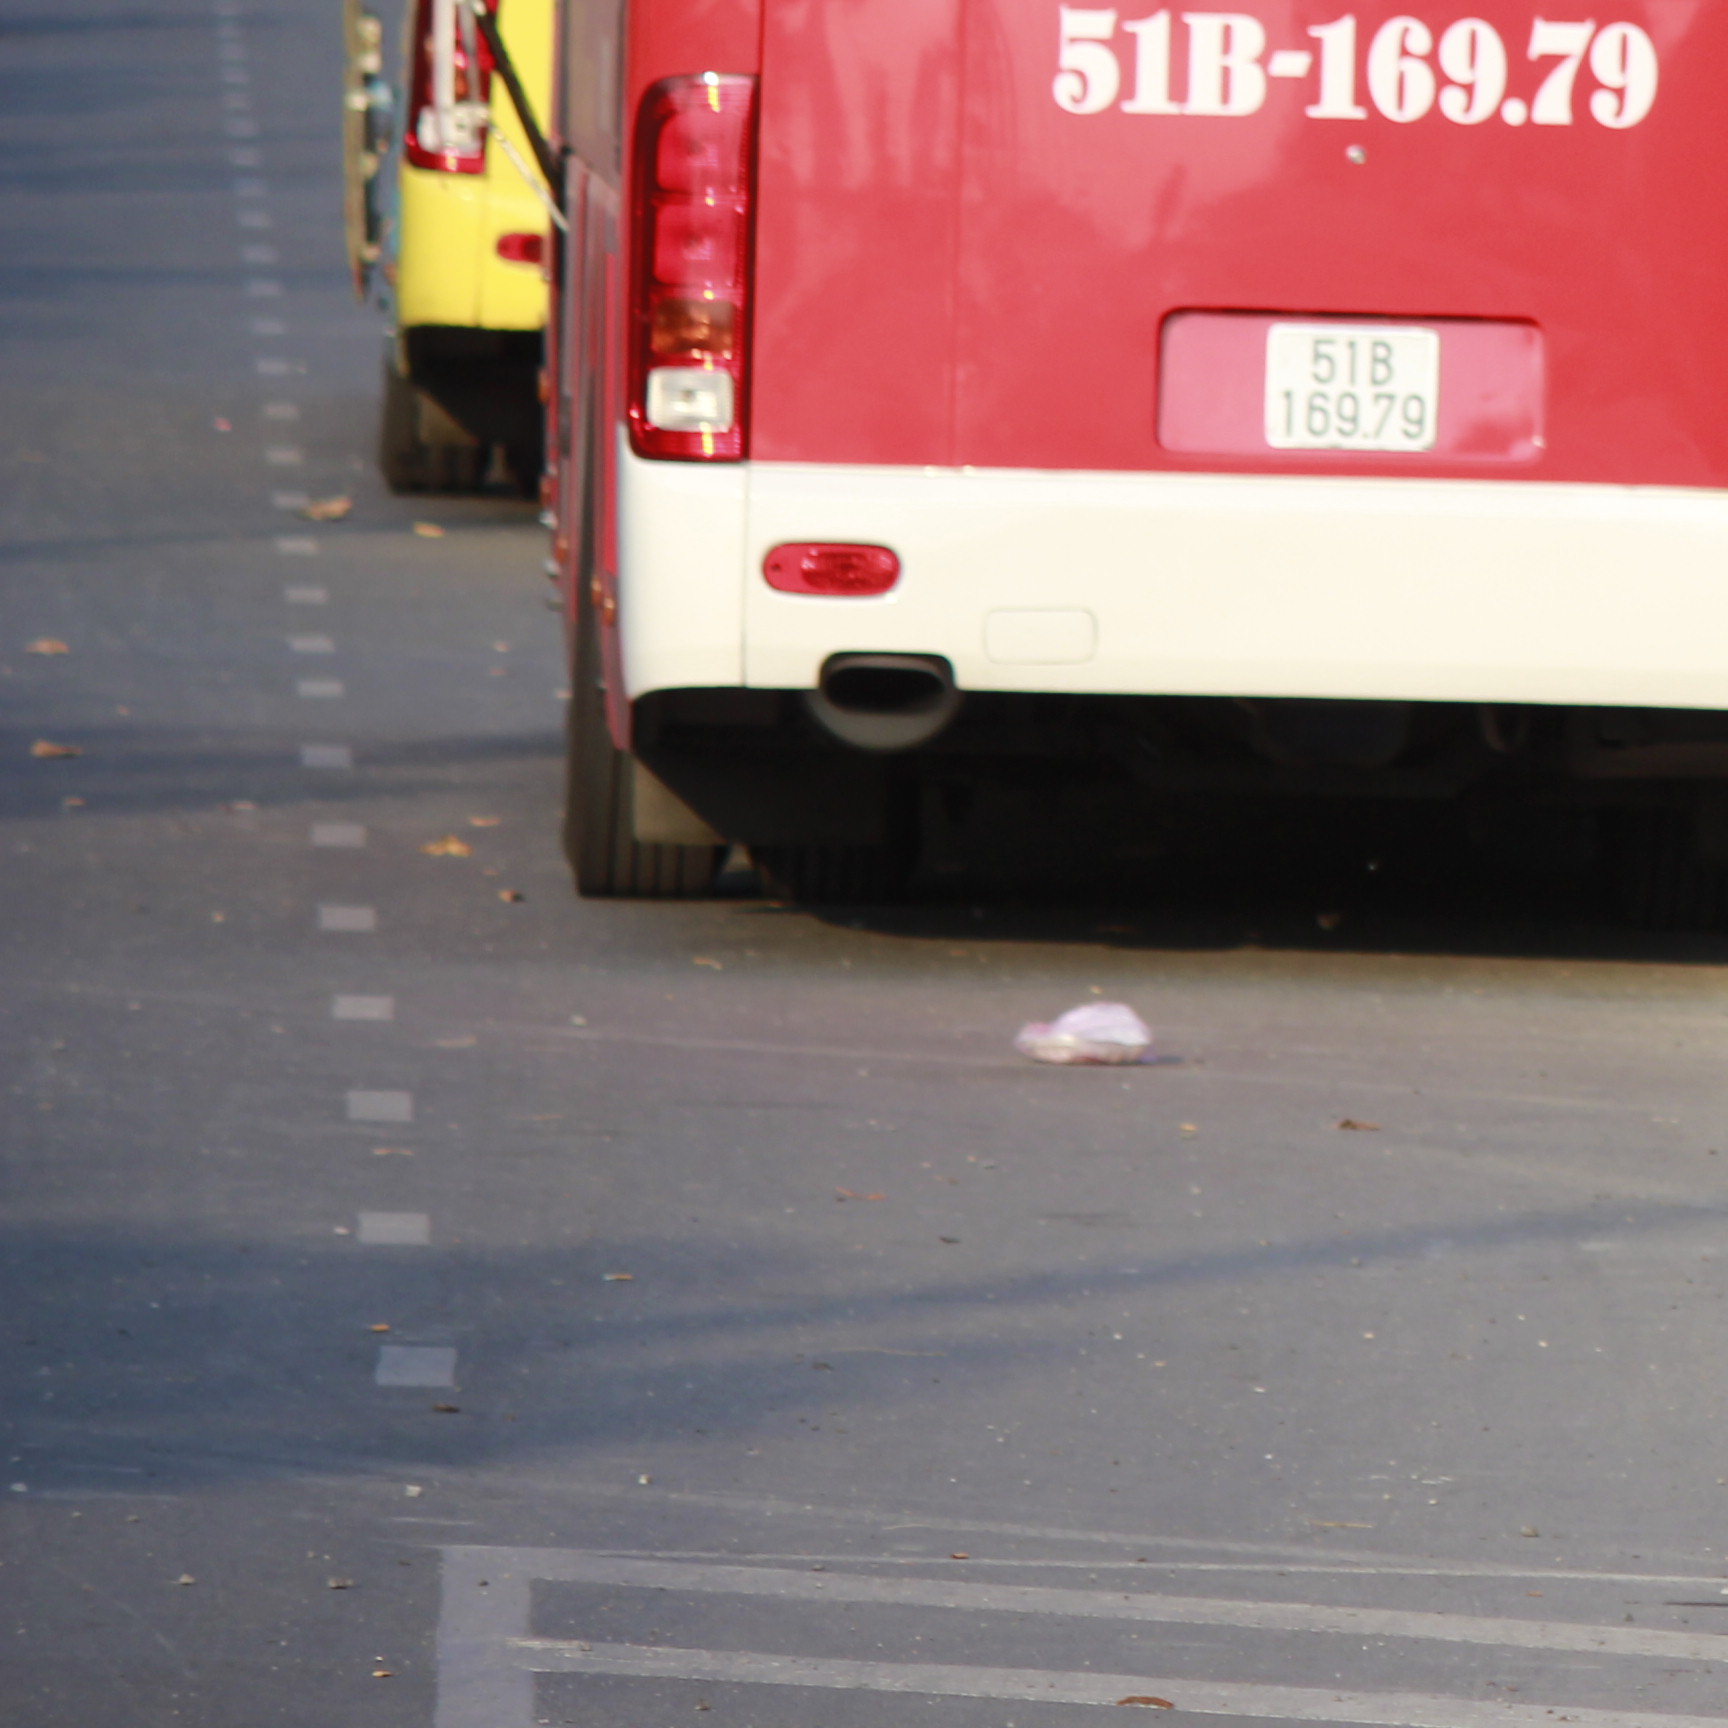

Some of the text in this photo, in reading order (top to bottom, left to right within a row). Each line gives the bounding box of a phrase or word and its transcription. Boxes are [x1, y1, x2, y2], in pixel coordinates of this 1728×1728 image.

[1052, 5, 1659, 128] 51B-169.79
[1312, 338, 1394, 386] 51B
[1282, 389, 1427, 439] 169.79
